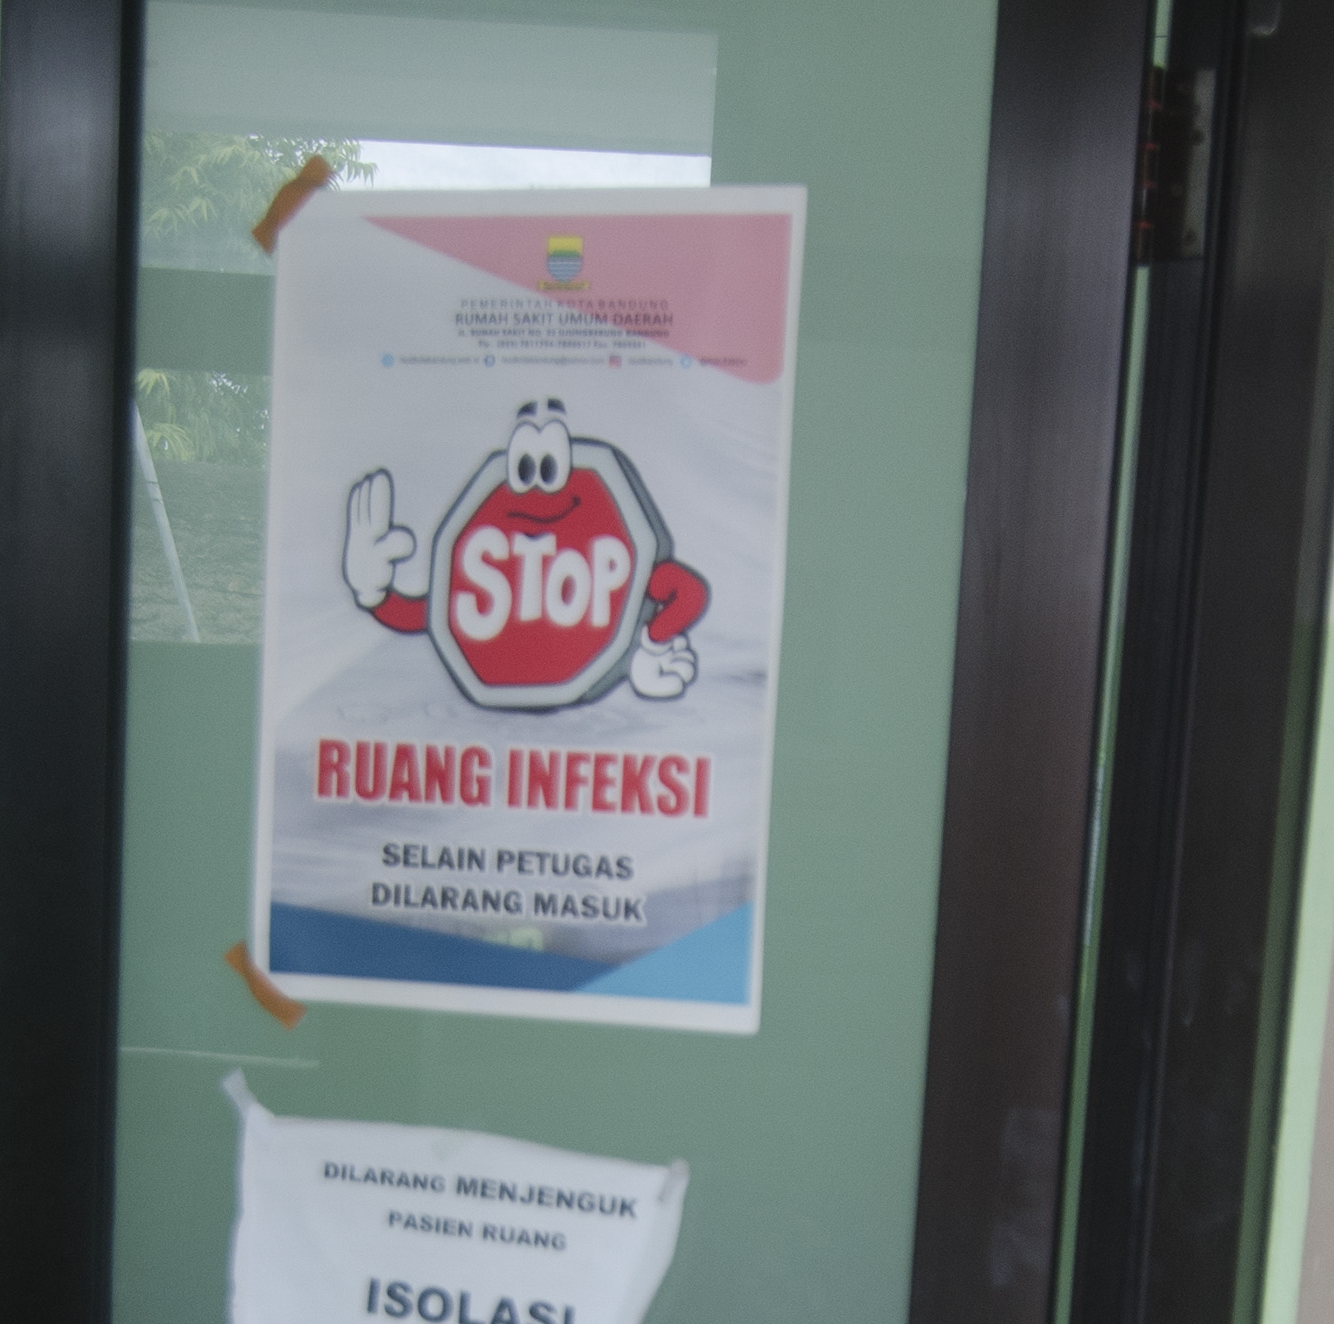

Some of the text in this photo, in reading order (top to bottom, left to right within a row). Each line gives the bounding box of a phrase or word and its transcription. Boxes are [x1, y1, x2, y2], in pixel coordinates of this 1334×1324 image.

[455, 312, 673, 327] RUMAH SAKIT UMUM DAERAH
[455, 526, 631, 642] STOP
[315, 738, 712, 818] RUANG INFEKSI
[382, 843, 634, 880] SELAIN PETUGAS
[371, 882, 646, 922] DILARANG MASUK
[323, 1161, 638, 1219] DILARANG MENJENGUK
[387, 1210, 567, 1251] PASIEN RUANG
